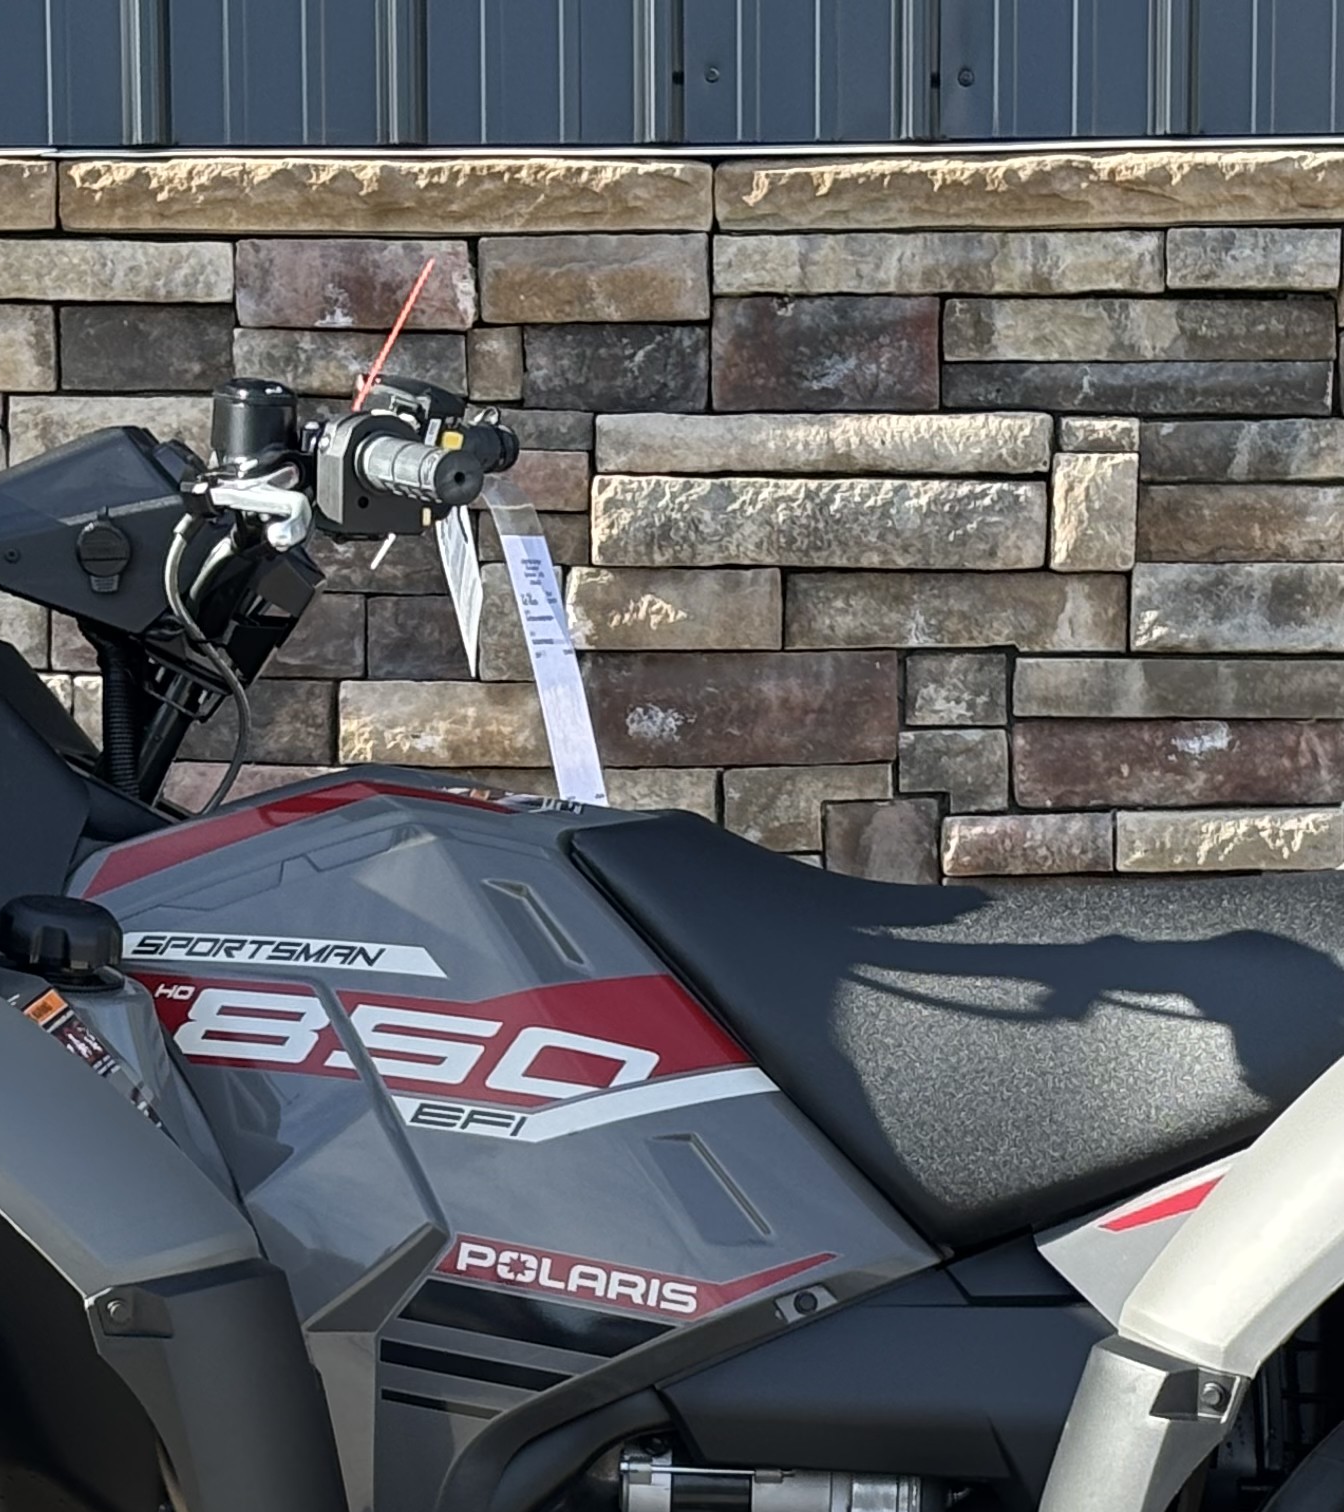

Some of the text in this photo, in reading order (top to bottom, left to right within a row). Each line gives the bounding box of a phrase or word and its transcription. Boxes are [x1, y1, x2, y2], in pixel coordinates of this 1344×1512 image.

[131, 935, 386, 967] SPORTSMAN
[154, 983, 196, 1001] HO
[173, 987, 660, 1099] 850
[410, 1103, 528, 1136] EFI
[456, 1240, 698, 1314] POLARIS
